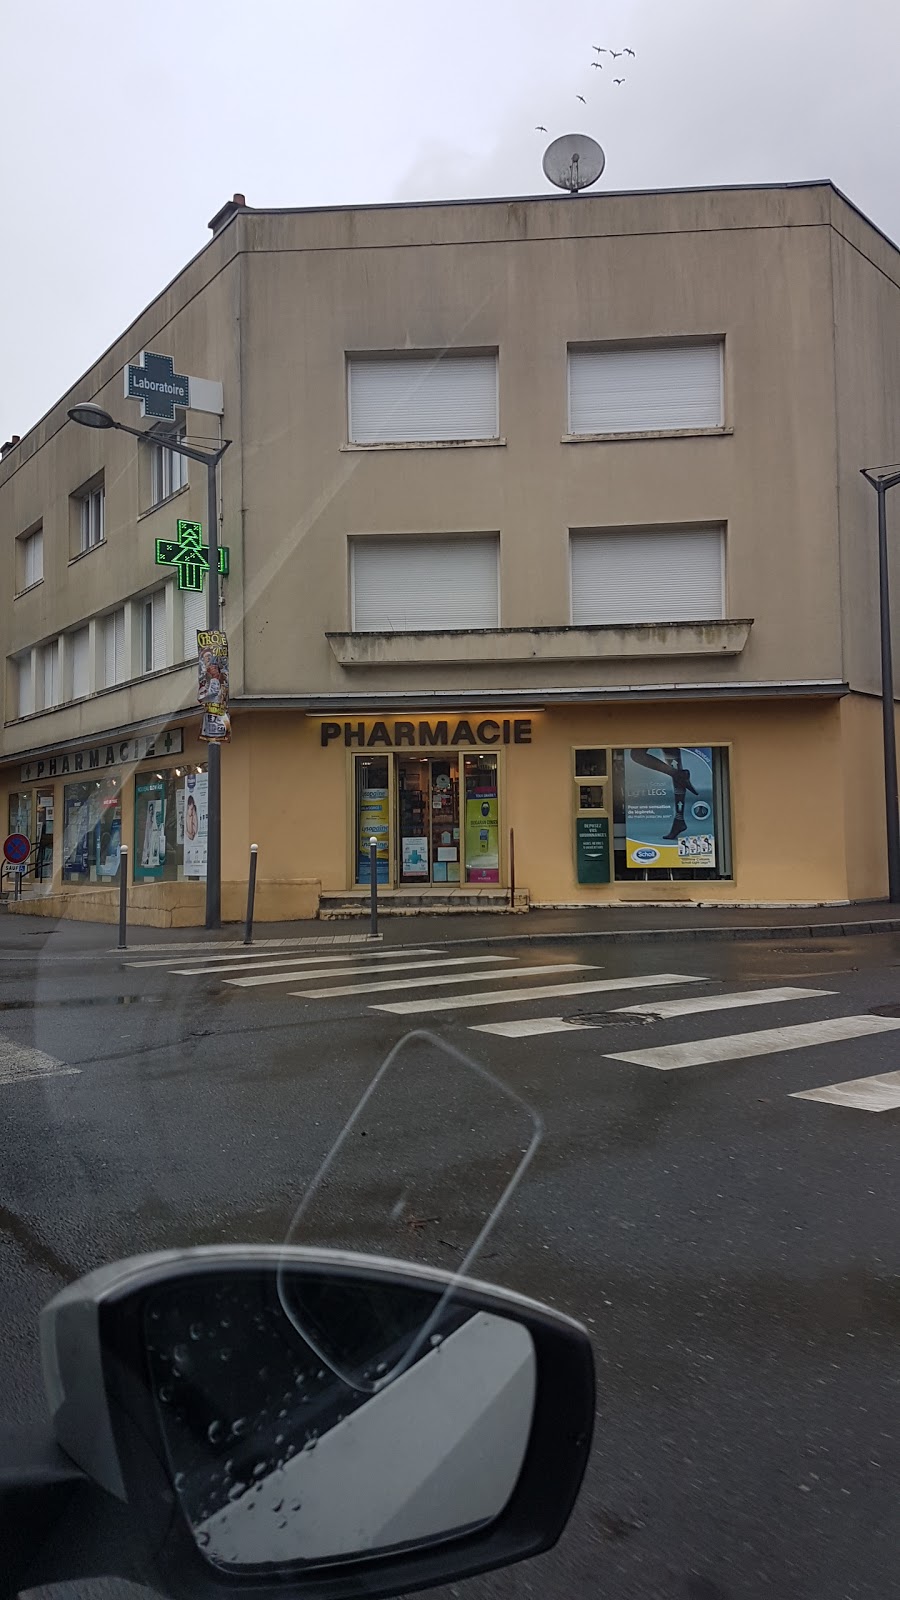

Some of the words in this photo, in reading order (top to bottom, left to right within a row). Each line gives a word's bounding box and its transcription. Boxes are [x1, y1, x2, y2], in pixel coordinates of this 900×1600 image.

[133, 375, 185, 397] Laboratoire
[320, 719, 533, 747] PHARMACIE
[37, 735, 156, 778] PHARMACIE
[647, 788, 667, 796] LEGS
[637, 850, 655, 858] Scholl
